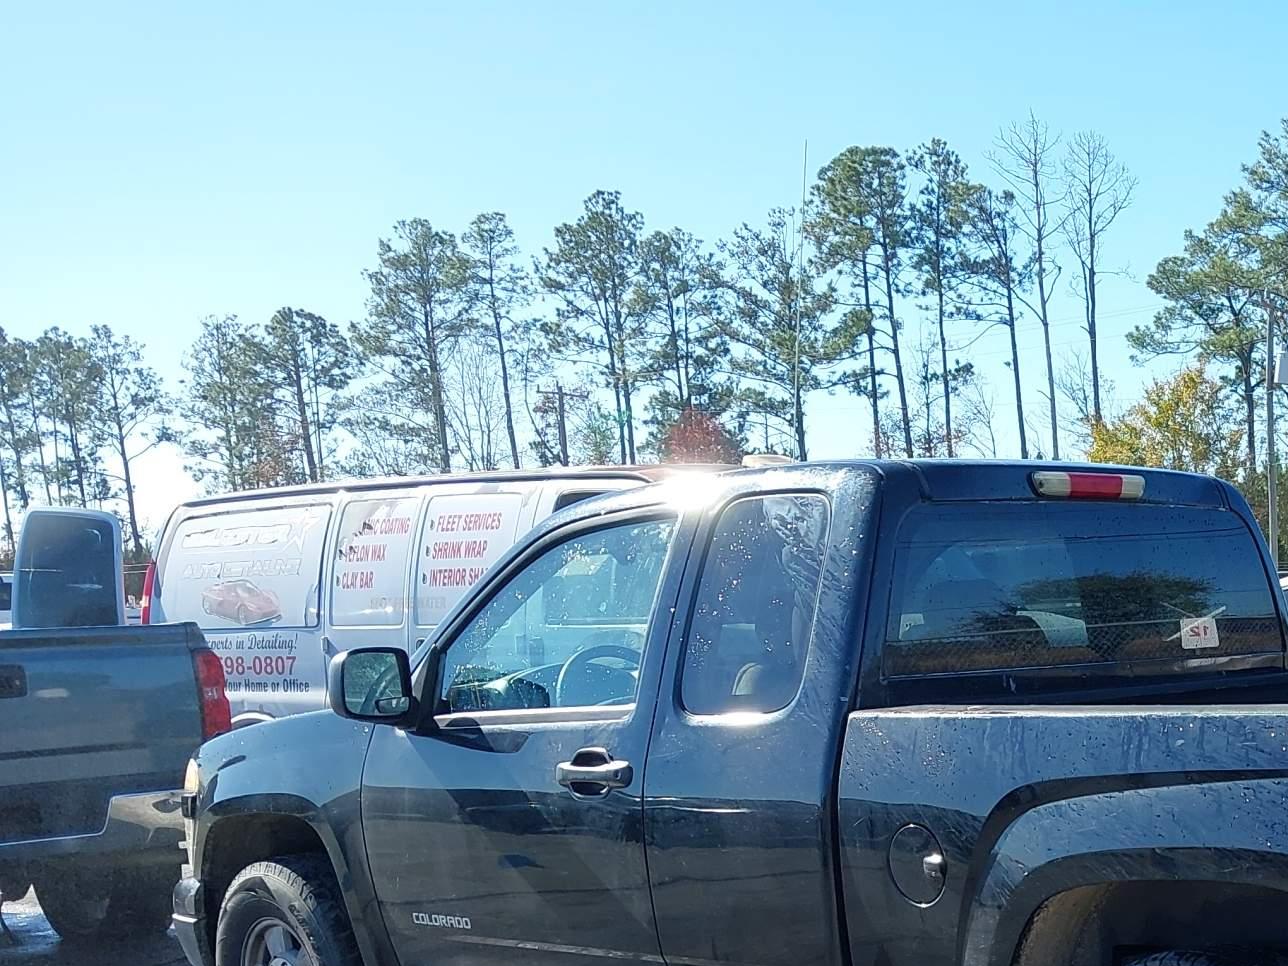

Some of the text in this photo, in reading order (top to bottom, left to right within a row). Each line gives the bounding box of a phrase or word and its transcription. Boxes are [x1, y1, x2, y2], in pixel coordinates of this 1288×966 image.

[380, 517, 410, 534] COATING
[436, 512, 502, 532] FLEET SERVICES
[371, 544, 387, 561] WAX
[432, 540, 488, 559] SHRINK WRAP
[342, 571, 374, 589] CLAY BAR
[429, 568, 466, 587] INTERIOR
[207, 633, 298, 654] perts in Detailing!
[221, 655, 297, 676] 98-0807
[244, 678, 269, 692] Home
[271, 682, 280, 692] or
[282, 678, 310, 693] Office
[412, 912, 472, 929] COLORADO
